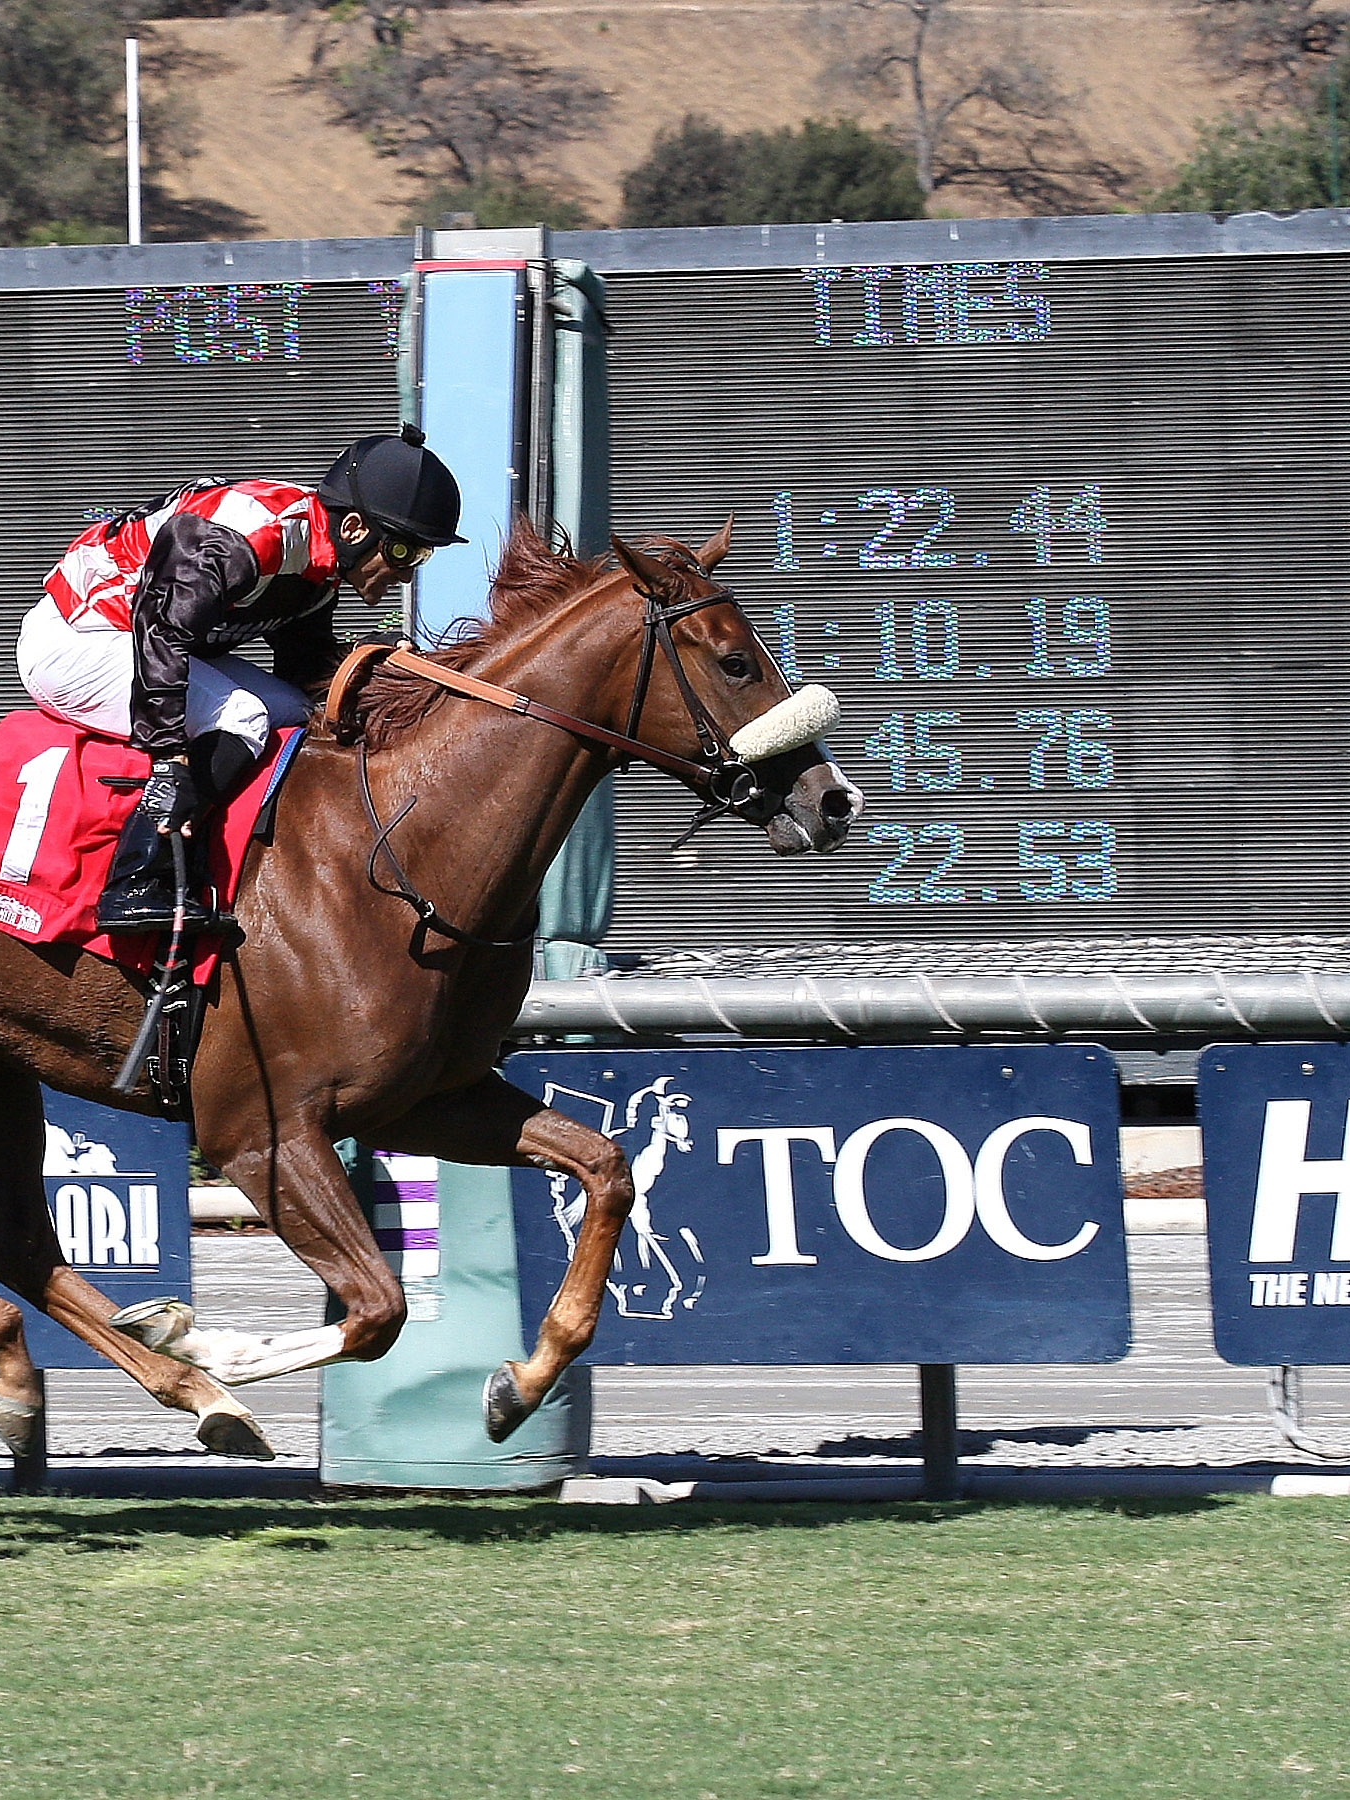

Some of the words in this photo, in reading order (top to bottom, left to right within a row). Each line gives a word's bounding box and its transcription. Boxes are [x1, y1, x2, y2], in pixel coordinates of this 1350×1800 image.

[124, 281, 312, 364] POST
[801, 262, 1051, 346] TIMES
[864, 709, 1116, 792] 45.76
[0, 745, 71, 886] 1
[867, 821, 1119, 904] 22.53
[46, 1183, 160, 1265] ARK
[716, 1115, 1101, 1265] TOC
[1249, 1273, 1308, 1306] THE
